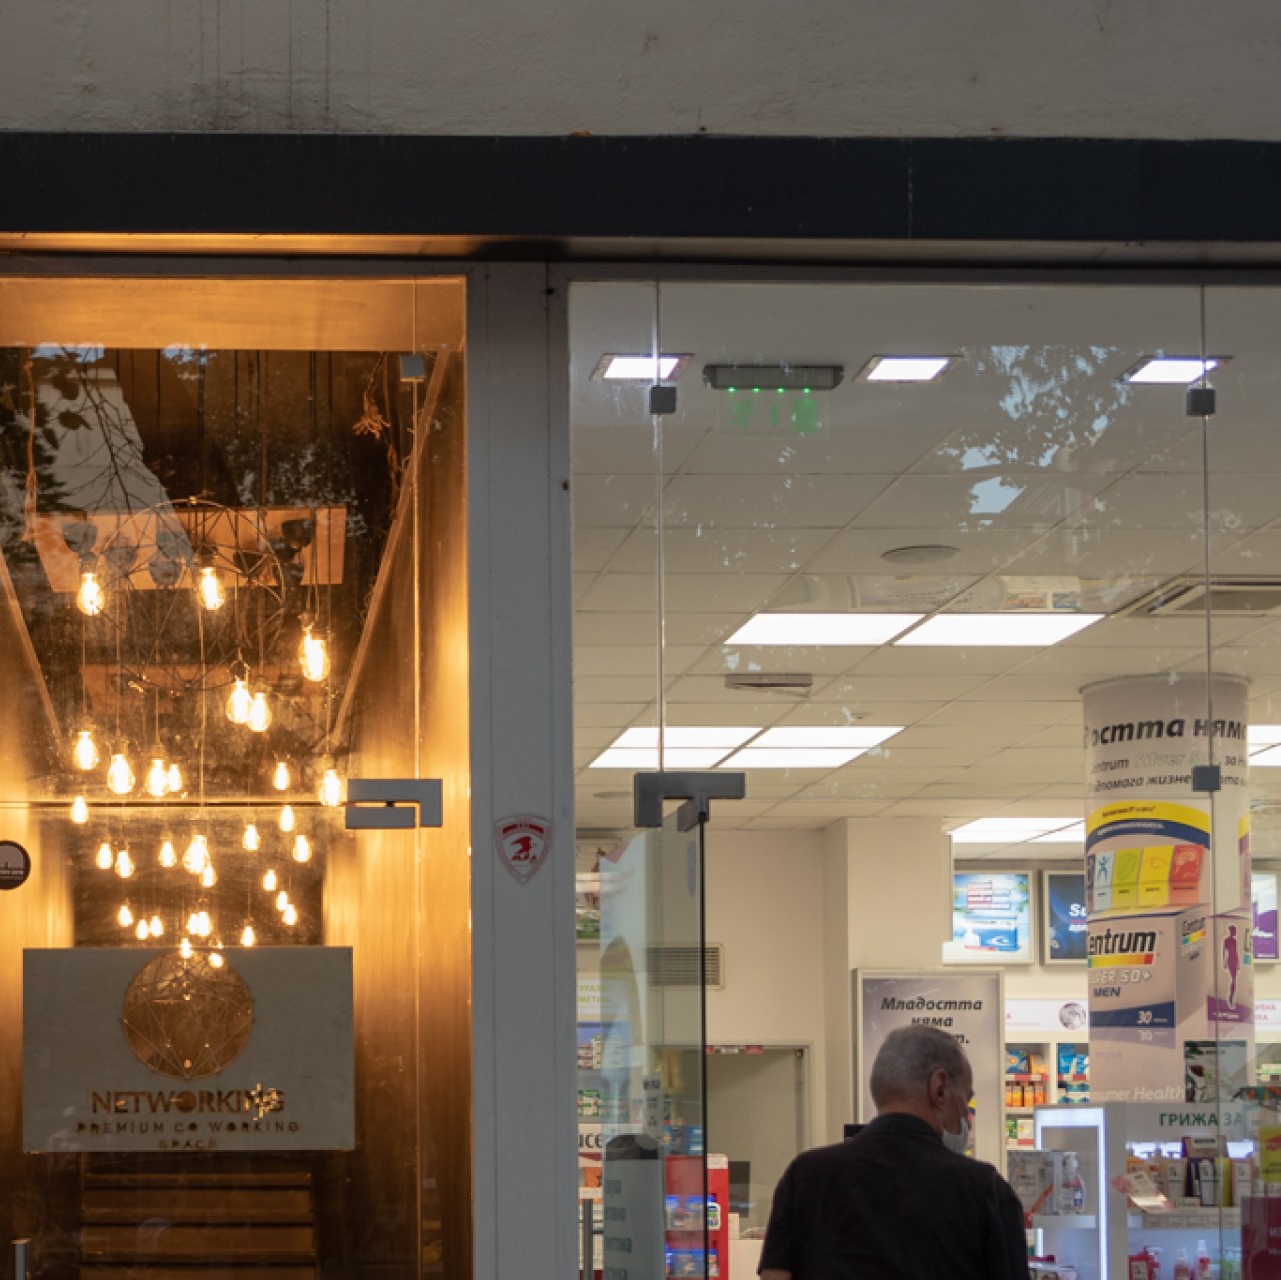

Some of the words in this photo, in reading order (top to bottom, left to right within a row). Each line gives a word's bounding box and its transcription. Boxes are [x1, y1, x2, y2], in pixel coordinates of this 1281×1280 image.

[881, 996, 984, 1011] Младостта
[1134, 1085, 1186, 1101] Health
[91, 1089, 286, 1114] NETWORKING
[76, 1120, 165, 1135] PREMIUM
[208, 1120, 301, 1133] WORKING
[1159, 1113, 1219, 1128] ГРИЖА
